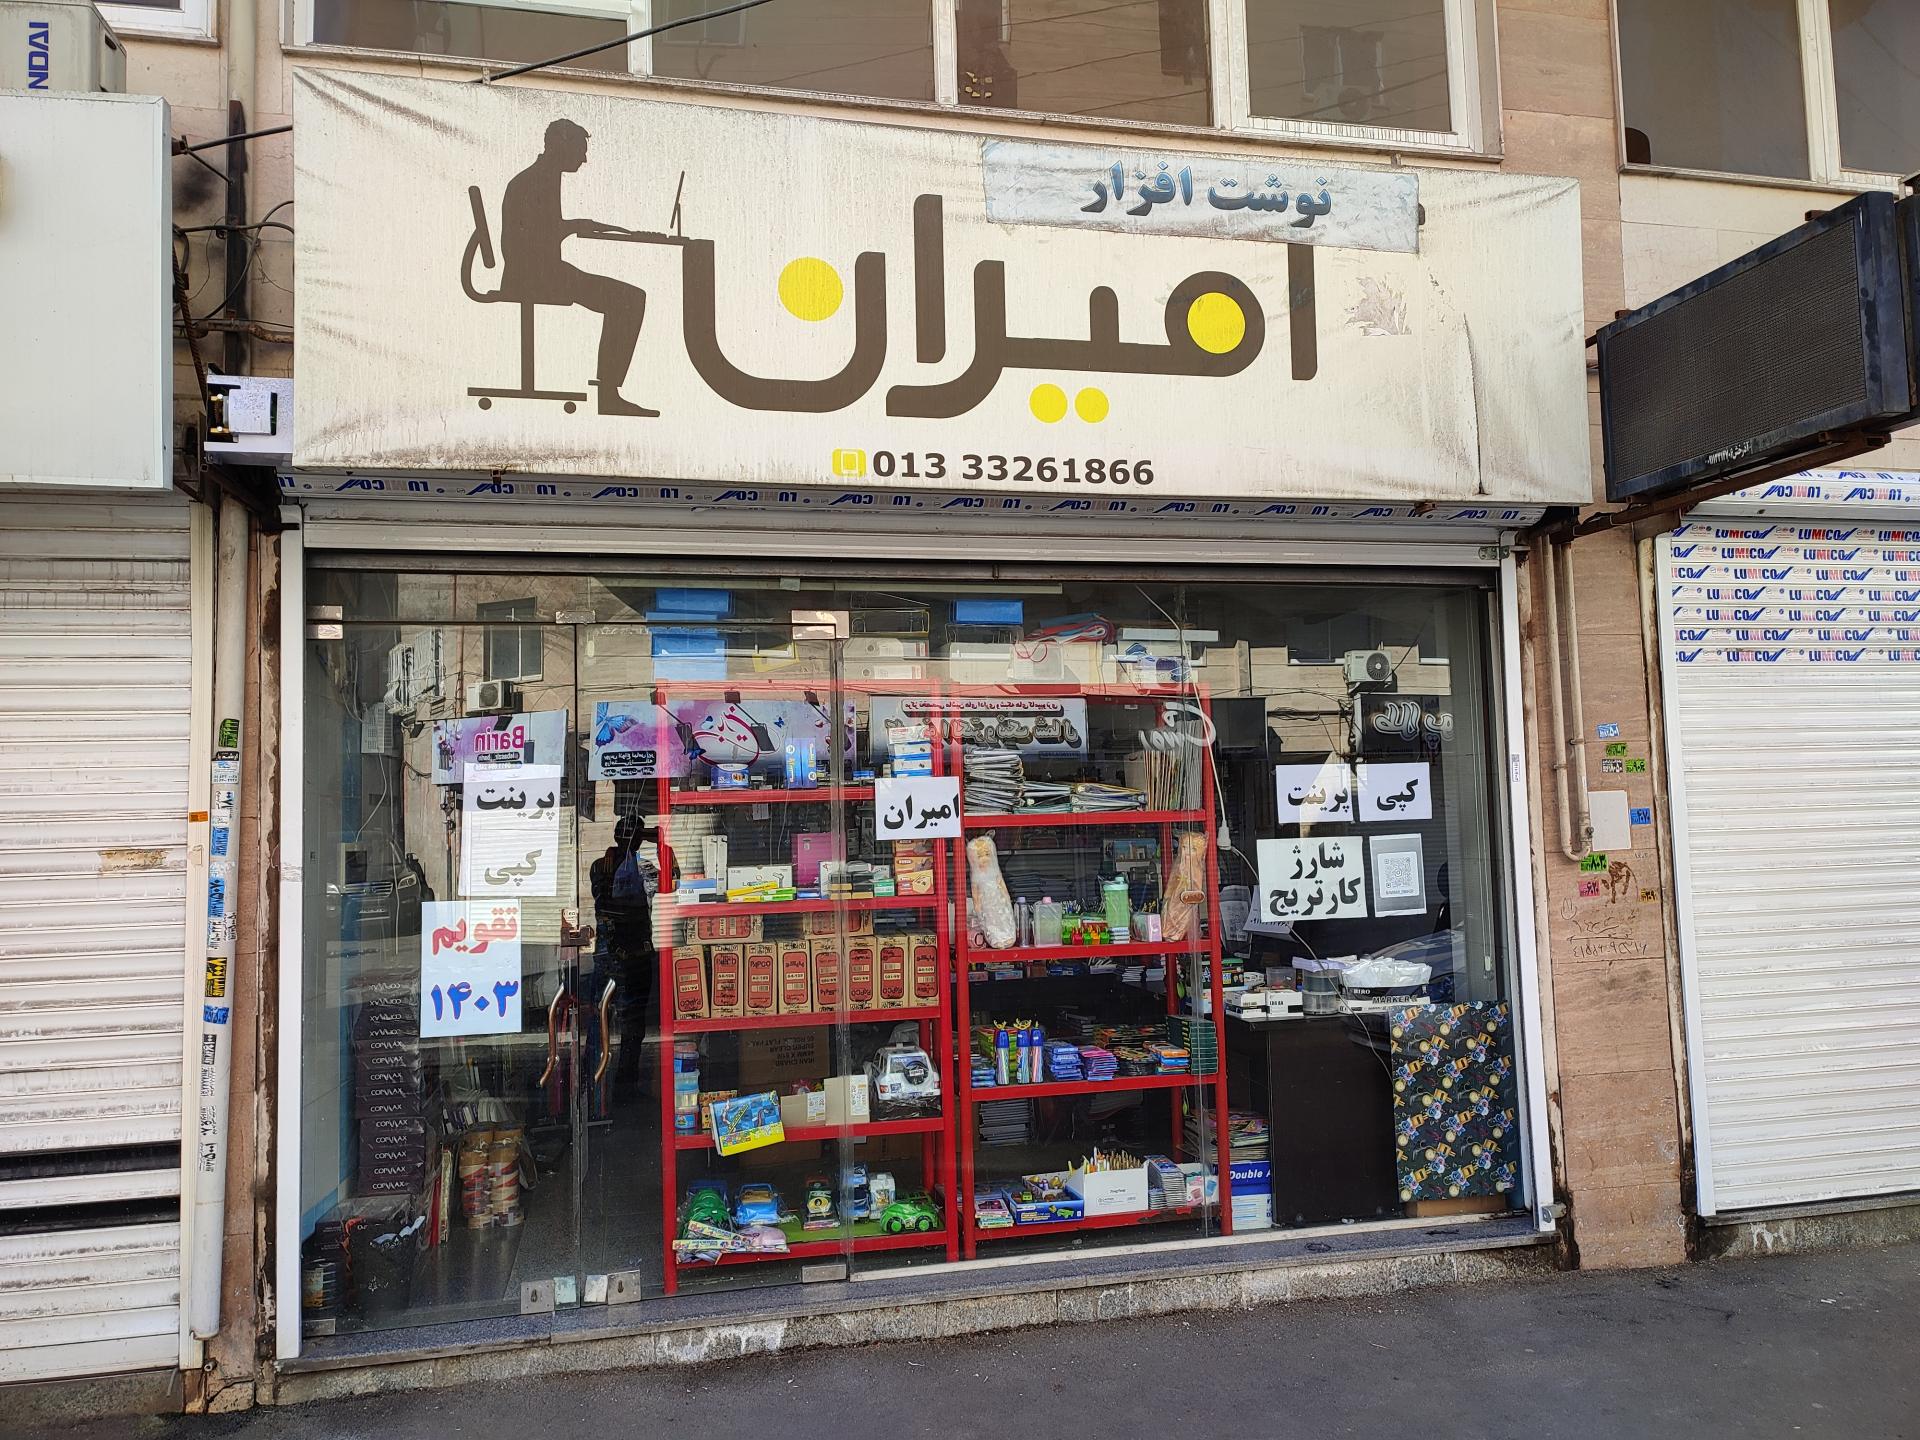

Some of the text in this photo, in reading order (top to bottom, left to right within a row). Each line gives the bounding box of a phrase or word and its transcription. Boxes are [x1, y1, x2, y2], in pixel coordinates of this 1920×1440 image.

[28, 21, 49, 90] NDAI
[1080, 159, 1332, 229] نوشت افزار
[682, 194, 1318, 423] امیران
[872, 449, 1155, 485] 013 33261866
[1715, 528, 1760, 540] LUMICO
[1798, 528, 1842, 541] LUMICO
[1721, 547, 1766, 560] LUMICO
[1803, 549, 1846, 561] LUMICO
[1733, 568, 1778, 580] LUMICO
[1816, 569, 1858, 581] LUMICO
[1706, 588, 1909, 601] LUMICO LUMICO LUMICO
[1706, 609, 1909, 622] LUMICO LUMICO LUMICO
[1736, 629, 1779, 641] LUMICO
[1818, 629, 1860, 641] LUMICO
[1726, 650, 1920, 662] LUMICO LUMICO LUMIC
[477, 786, 555, 820] پرینت
[883, 793, 960, 830] امیران
[1287, 784, 1350, 813] پرینت
[1376, 779, 1419, 812] کپی
[484, 848, 543, 887] کپی
[1290, 842, 1345, 880] شارژ
[1269, 877, 1361, 916] کارتریج
[432, 906, 519, 956] تقویم
[430, 980, 519, 1021] ۱۴۰۳
[1230, 1168, 1263, 1181] Double
